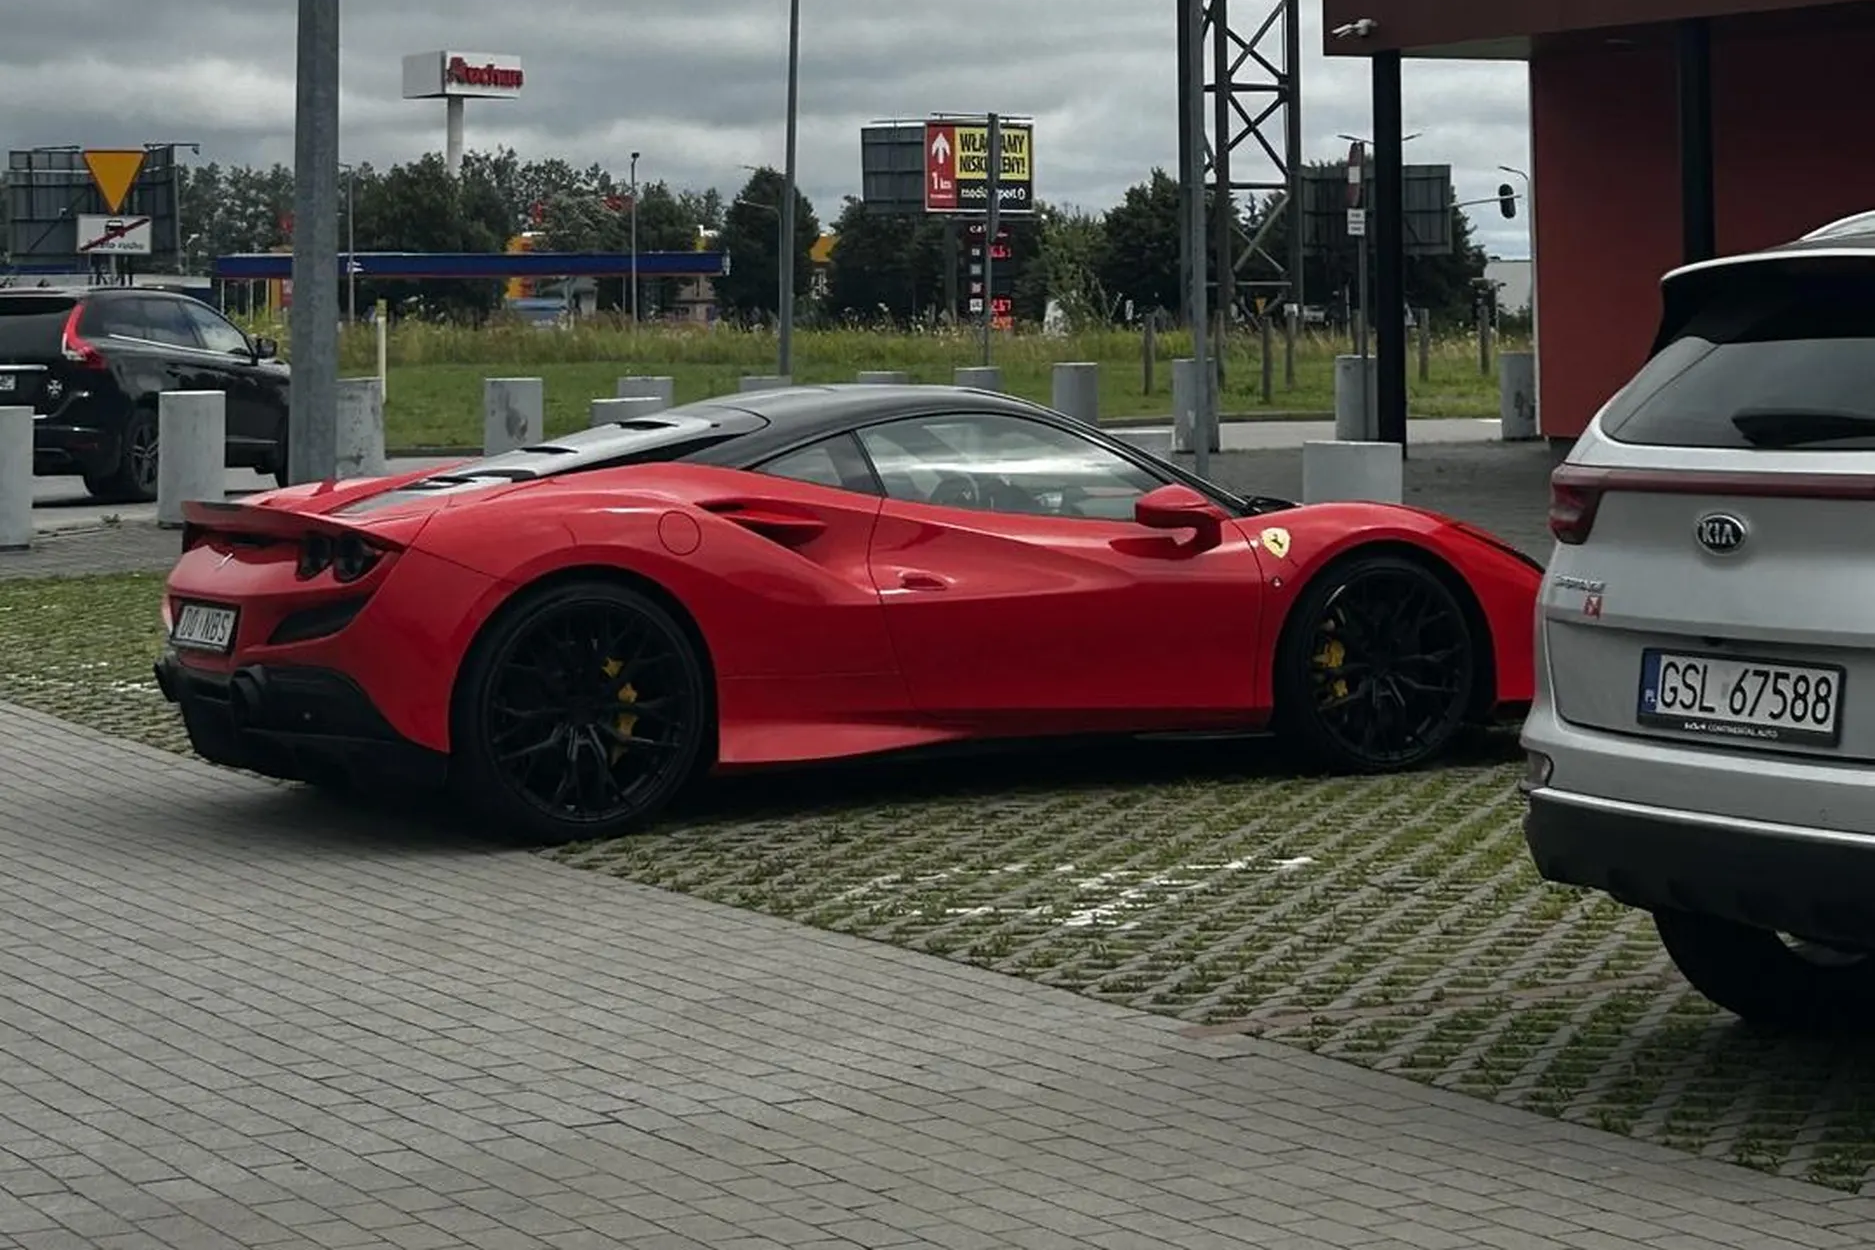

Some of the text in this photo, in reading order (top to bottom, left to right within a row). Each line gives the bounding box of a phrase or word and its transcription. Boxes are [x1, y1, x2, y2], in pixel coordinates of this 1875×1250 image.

[1702, 521, 1737, 544] KIA
[1660, 661, 1716, 713] GSL
[1729, 668, 1832, 725] 67588
